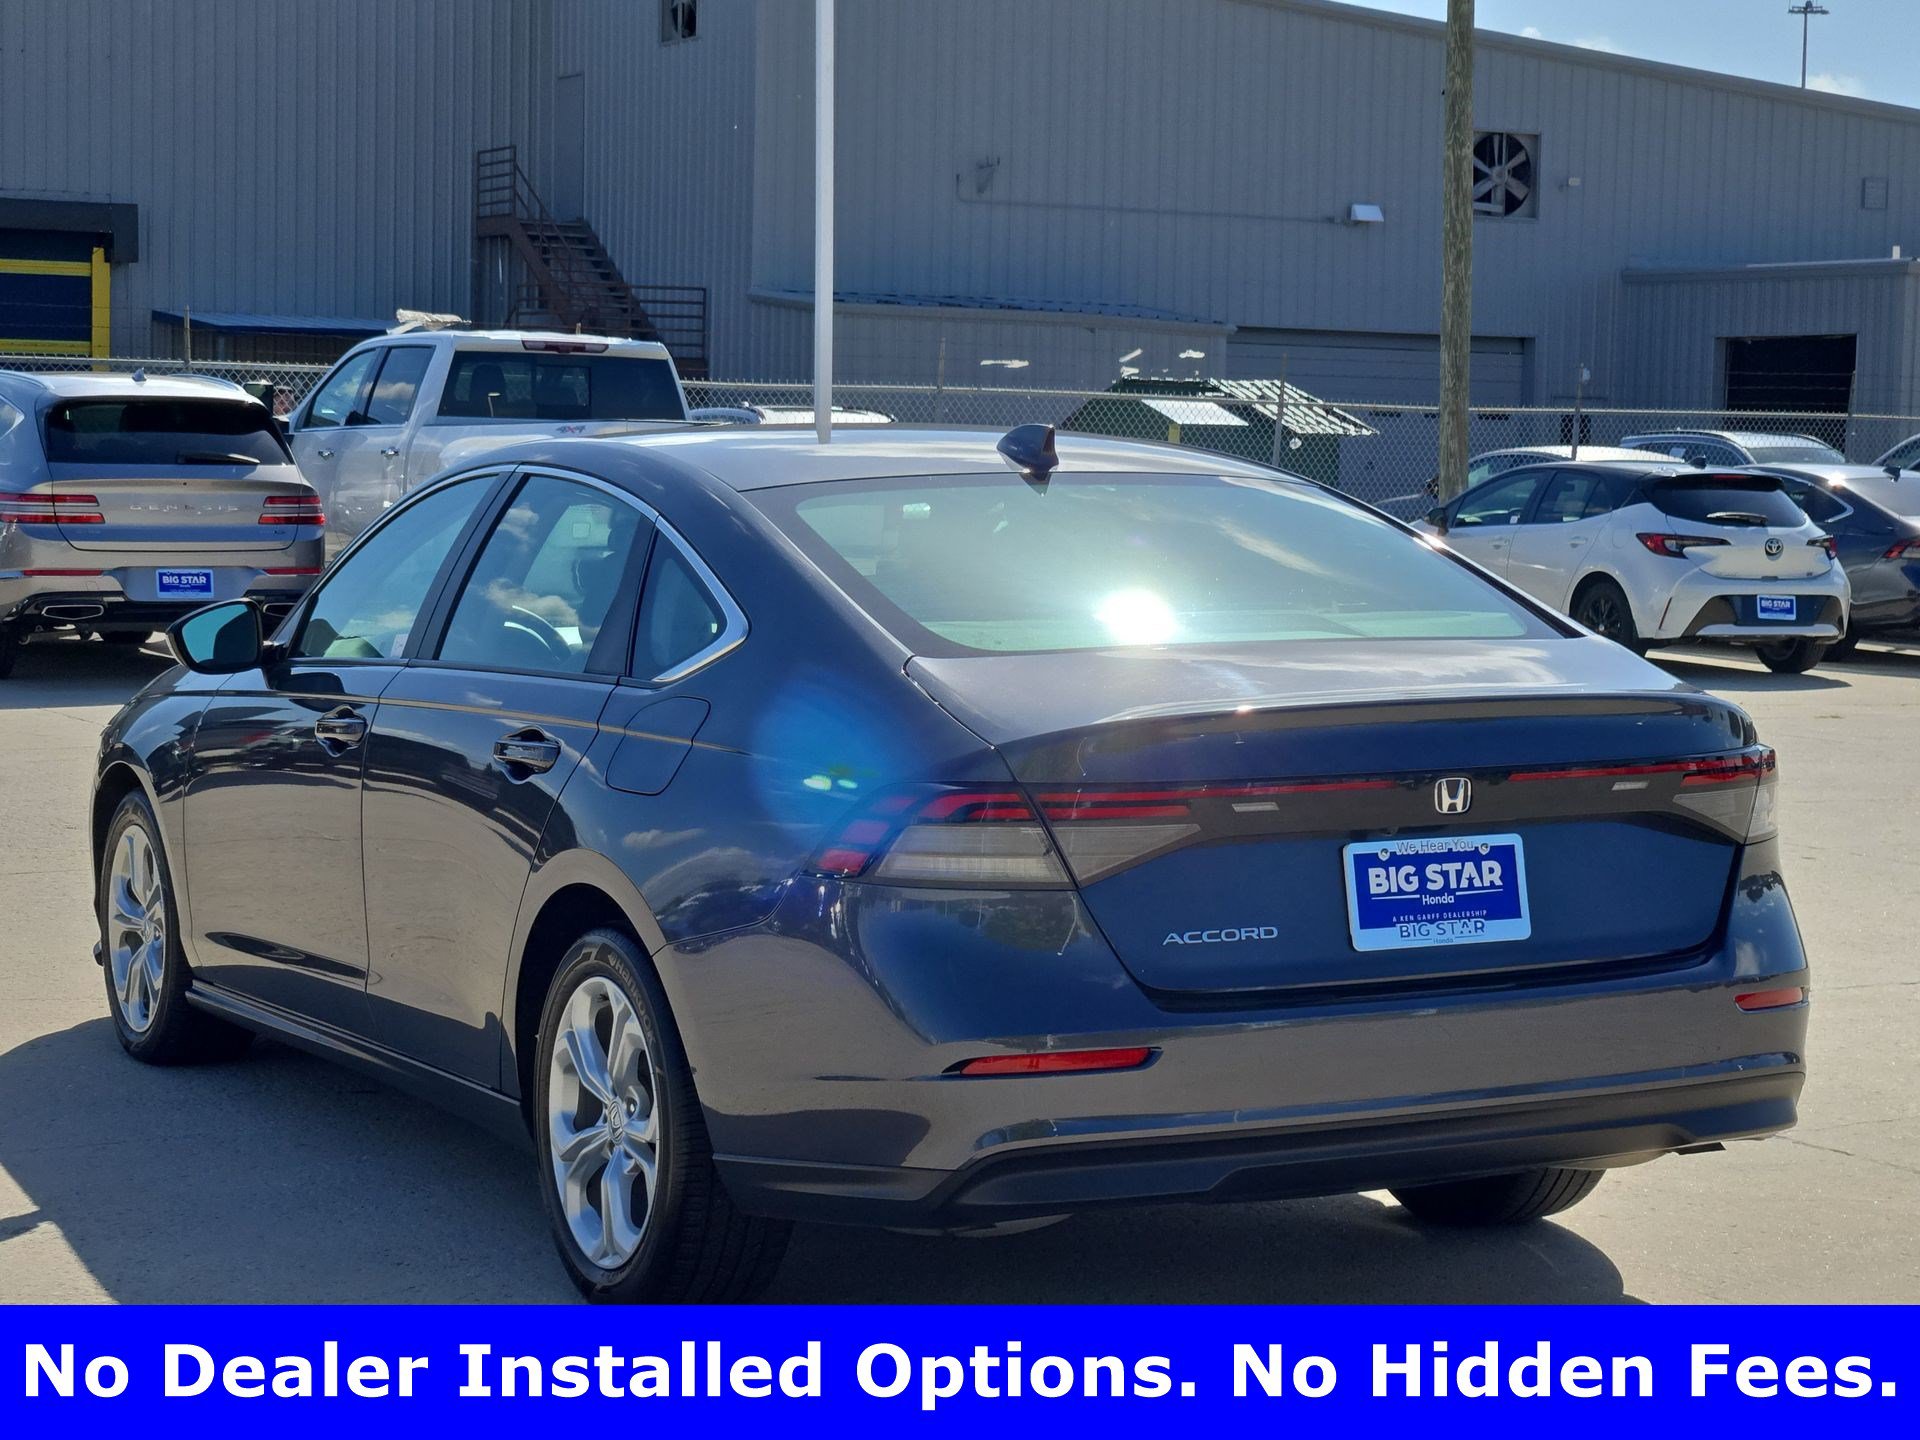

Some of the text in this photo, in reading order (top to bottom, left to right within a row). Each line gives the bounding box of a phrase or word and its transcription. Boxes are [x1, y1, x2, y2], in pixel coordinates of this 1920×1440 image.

[162, 575, 207, 584] BIG STAR
[1397, 838, 1474, 853] We Hear You
[1368, 860, 1503, 895] BIG STAR
[1422, 893, 1454, 905] Honda
[1400, 914, 1415, 922] KEN
[1417, 912, 1441, 921] GARFF
[1443, 909, 1488, 920] DEALERSHIP
[1162, 926, 1279, 946] ACCORD
[1400, 920, 1485, 938] BIG STAR
